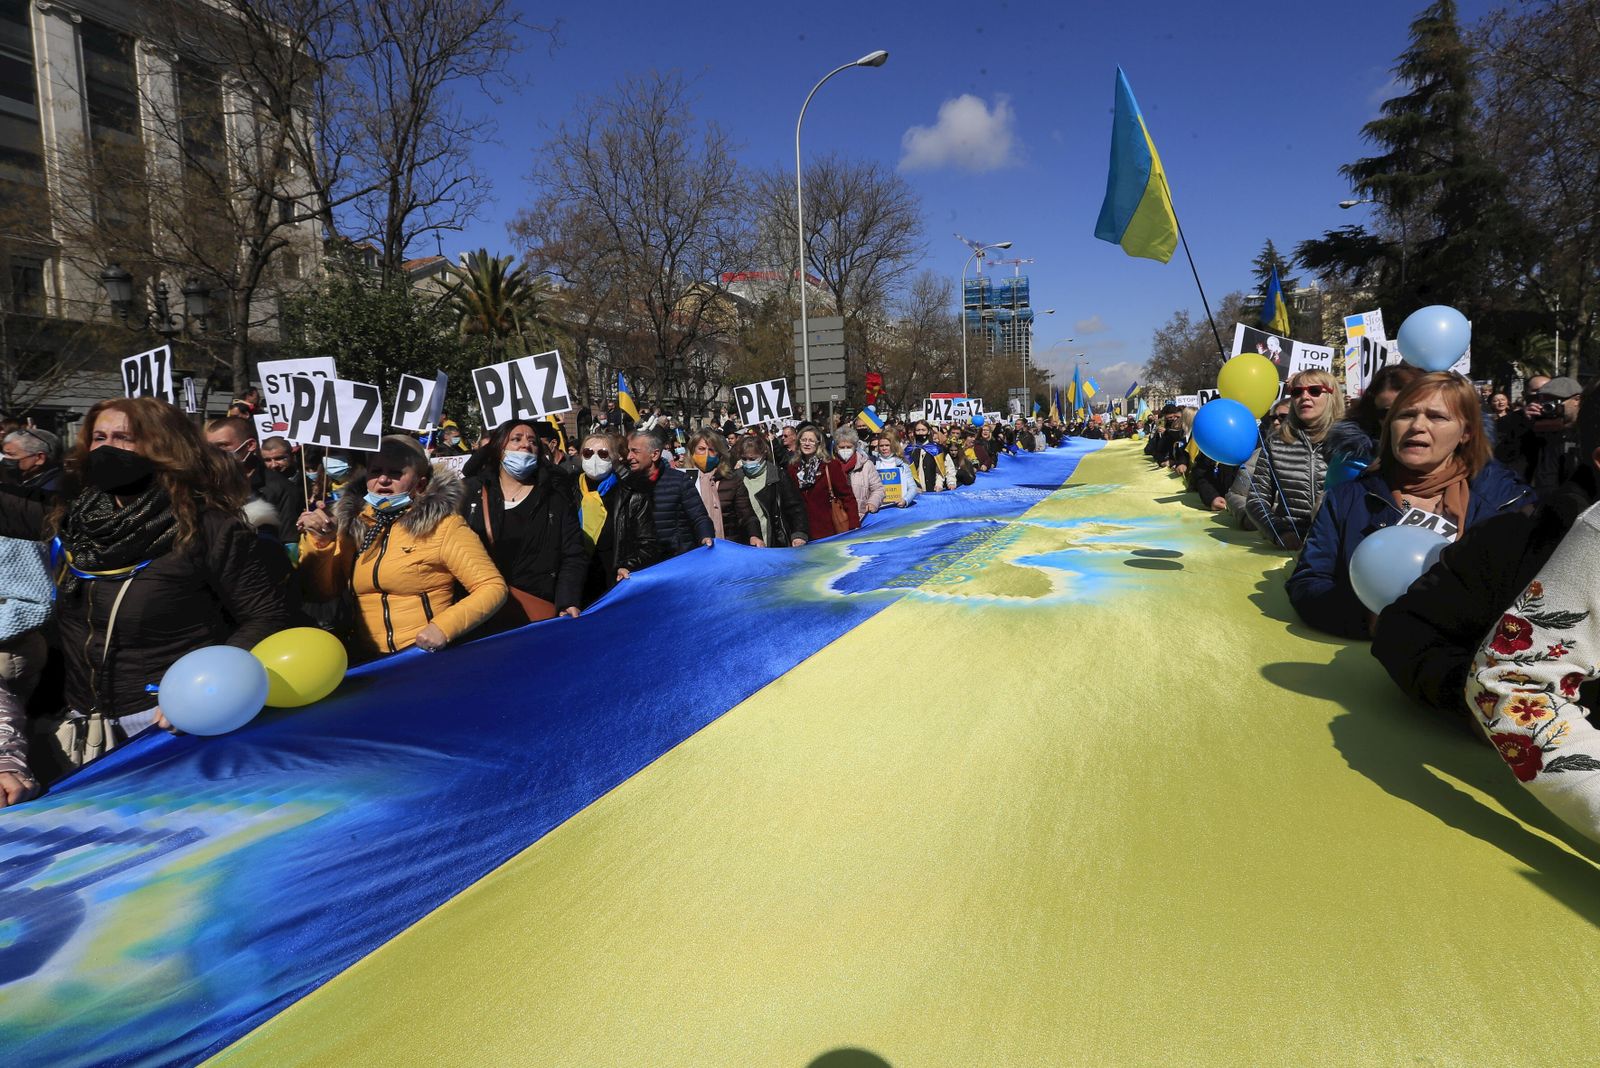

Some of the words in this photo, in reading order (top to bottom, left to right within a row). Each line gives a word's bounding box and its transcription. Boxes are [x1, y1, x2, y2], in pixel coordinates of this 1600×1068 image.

[1298, 363, 1329, 371] UTIN
[1301, 349, 1329, 361] TOP
[125, 349, 169, 400] PAZ
[474, 352, 569, 426] PAZ
[288, 376, 380, 450] PAZ
[737, 380, 792, 425] PAZ
[925, 399, 952, 420] PAZ
[957, 399, 982, 417] AZ
[880, 471, 897, 480] TOP
[1402, 510, 1458, 537] PAZ
